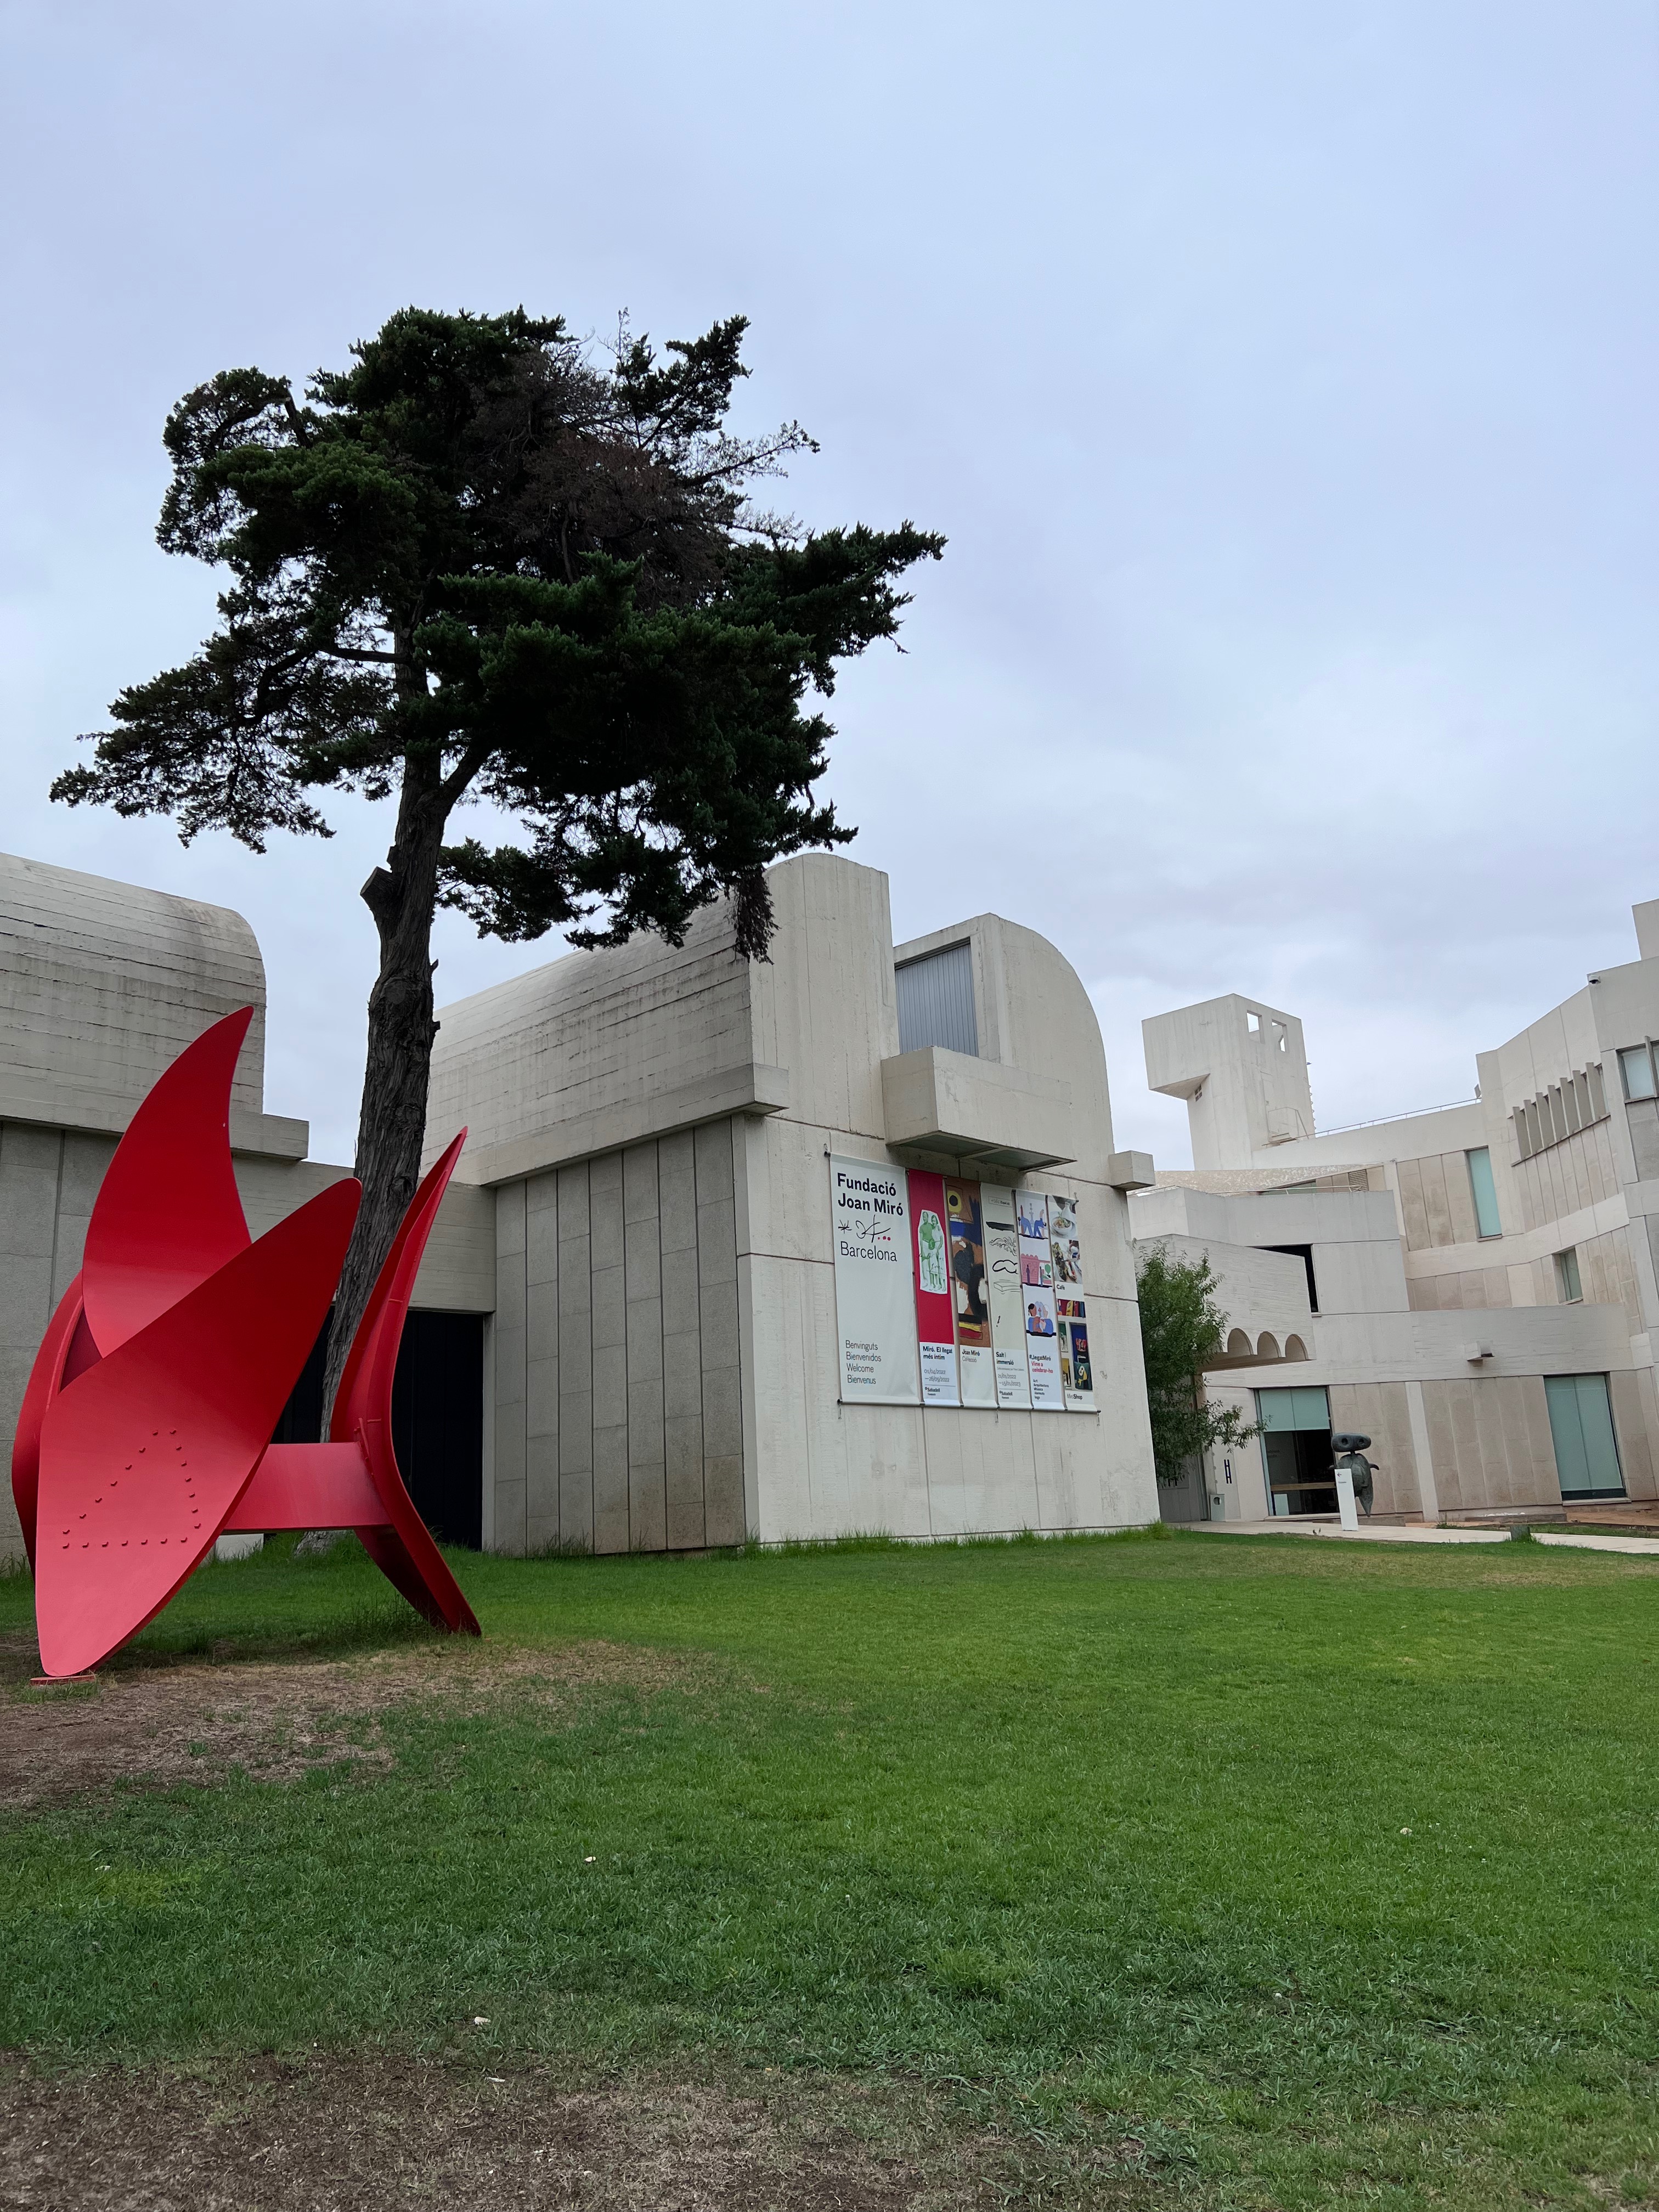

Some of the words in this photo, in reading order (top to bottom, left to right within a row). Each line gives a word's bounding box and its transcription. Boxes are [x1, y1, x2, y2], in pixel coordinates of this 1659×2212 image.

[837, 1172, 896, 1197] Fundació
[838, 1193, 871, 1211] Joan
[874, 1198, 903, 1216] Miró
[840, 1240, 898, 1262] Barcelona
[845, 1340, 878, 1352] Benvinguts
[846, 1351, 882, 1362] Bienvenidos
[847, 1363, 874, 1373] Welcome
[847, 1374, 876, 1384] Bienvenus
